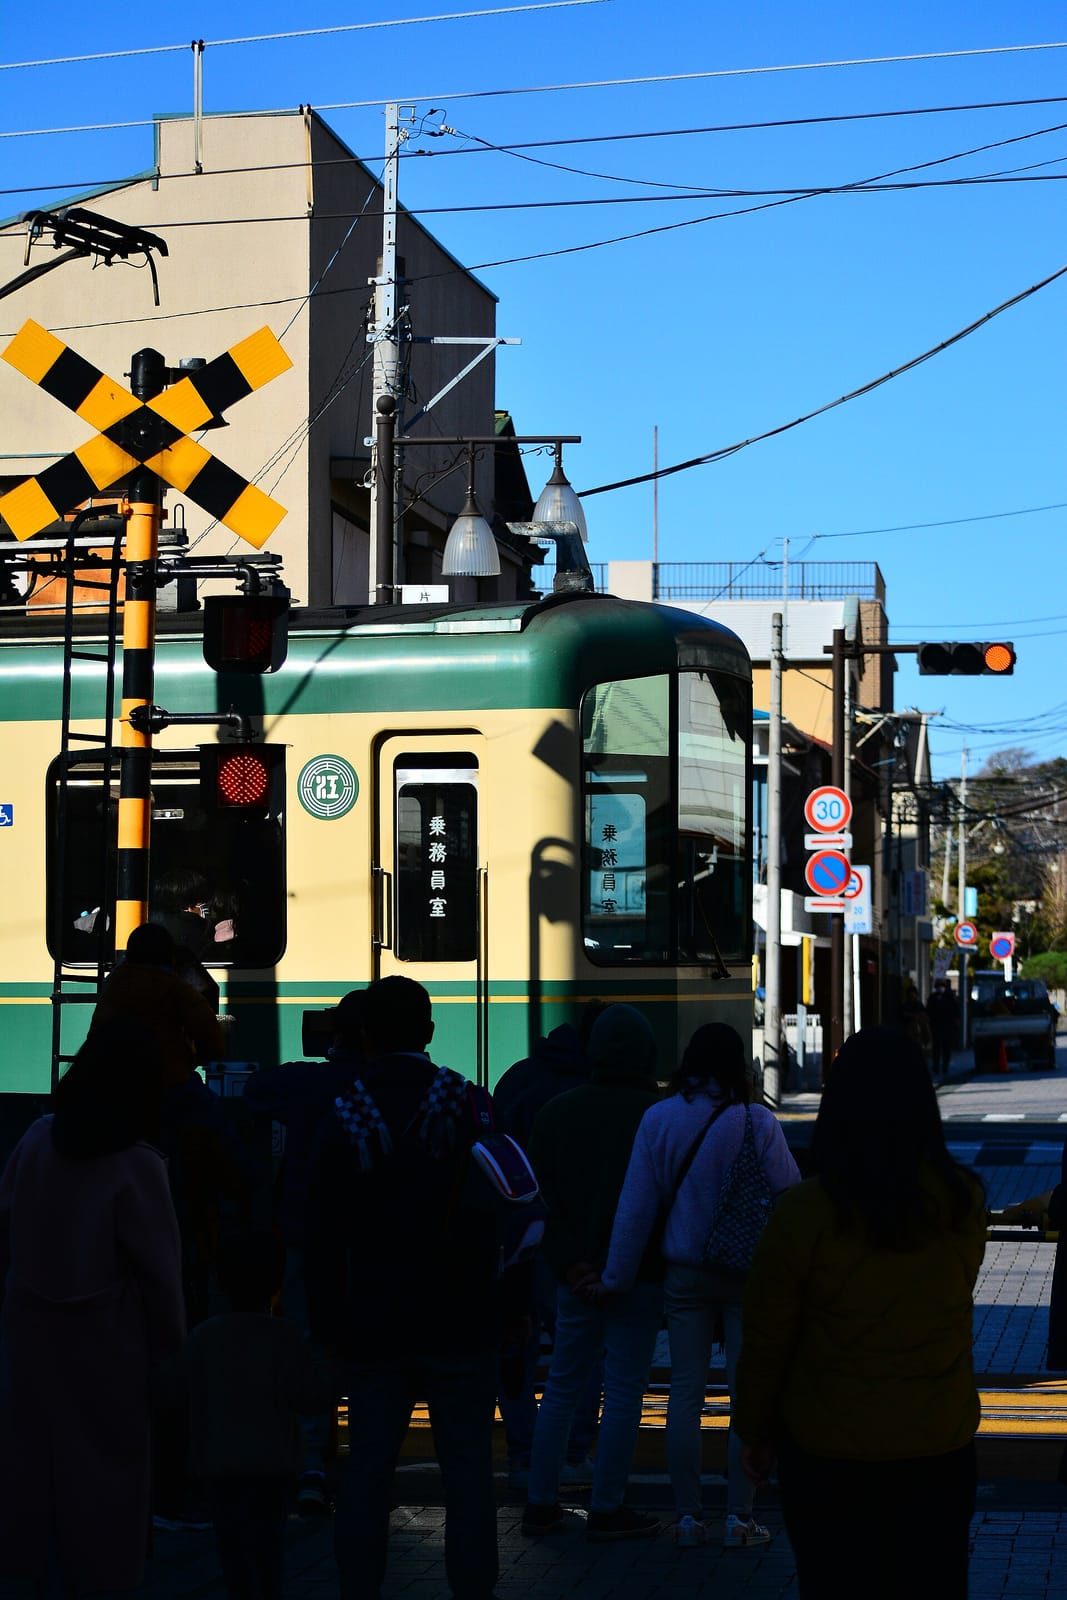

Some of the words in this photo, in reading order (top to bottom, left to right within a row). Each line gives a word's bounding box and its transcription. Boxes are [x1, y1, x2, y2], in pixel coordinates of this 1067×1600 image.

[817, 800, 841, 819] 30
[429, 816, 447, 917] 乗務員室
